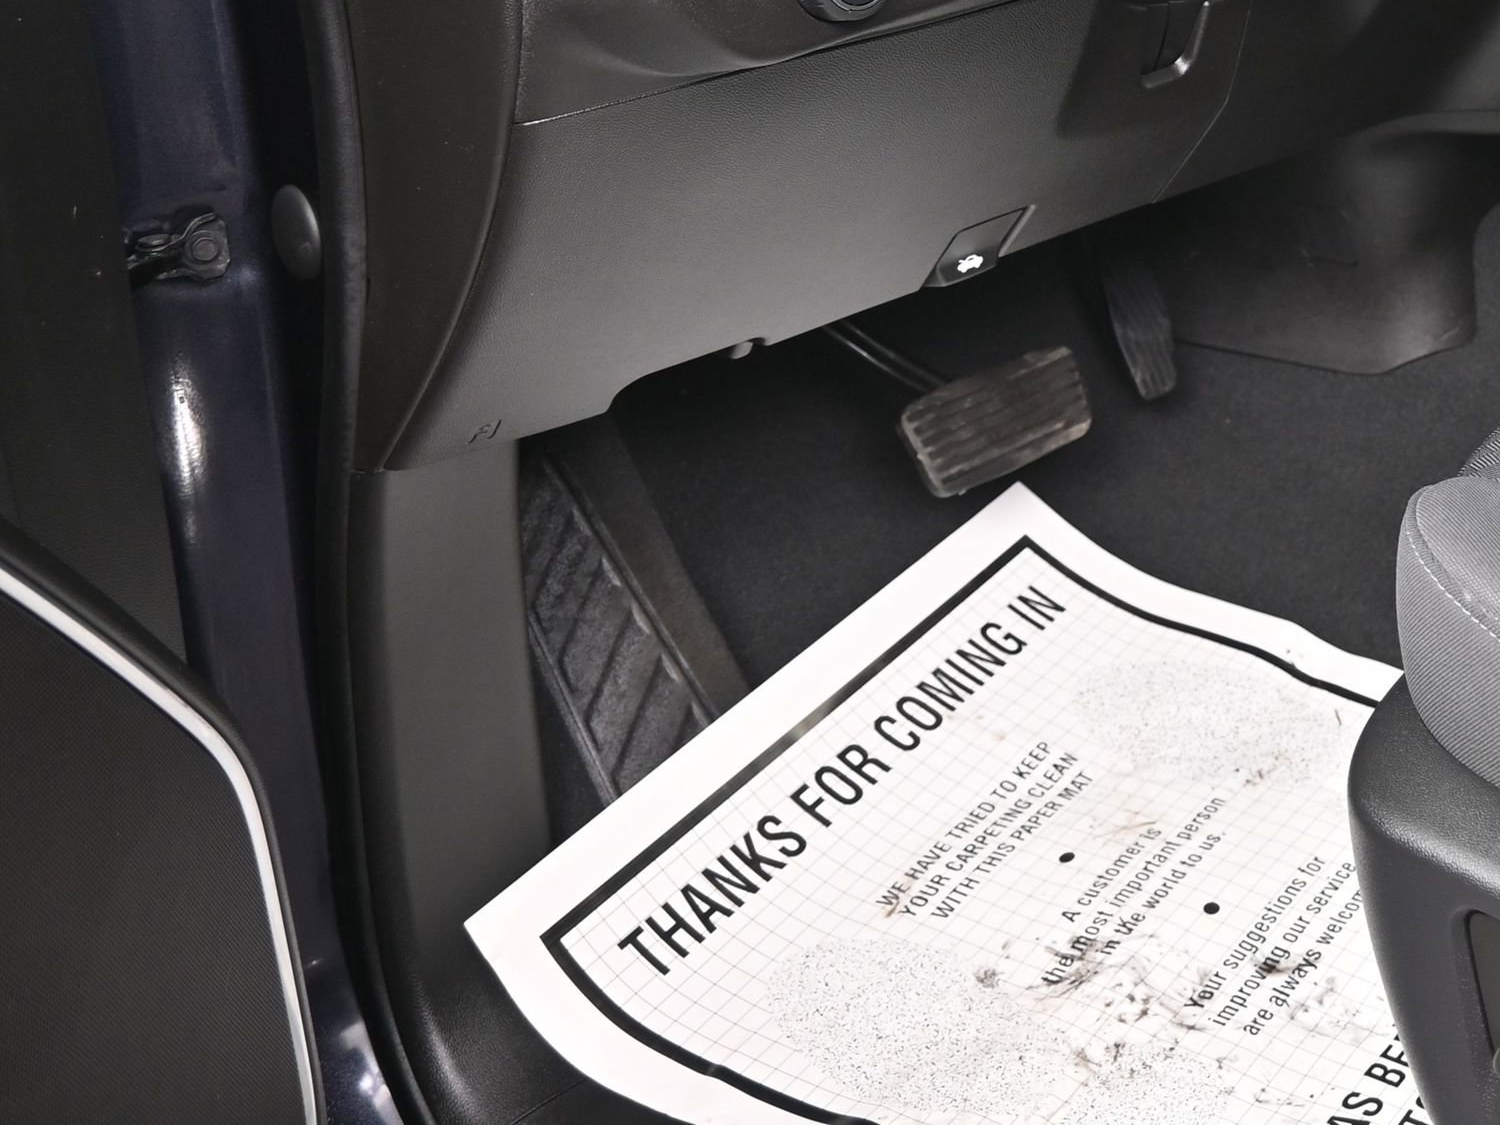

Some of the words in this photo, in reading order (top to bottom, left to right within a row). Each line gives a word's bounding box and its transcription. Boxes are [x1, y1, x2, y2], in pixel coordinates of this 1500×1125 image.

[617, 815, 807, 976] THANKS
[789, 744, 892, 828] FOR
[873, 622, 1028, 752] COMING
[1007, 585, 1067, 631] IN
[875, 881, 912, 908] WE
[904, 840, 953, 881] HAVE
[945, 801, 996, 841] TRIED
[990, 779, 1018, 800] TO
[1012, 741, 1052, 780] KEEP
[899, 874, 951, 918] YOUR
[945, 797, 1032, 873] CARPETING
[1027, 752, 1079, 799] CLEAN
[931, 876, 980, 920] WITH
[973, 842, 1016, 876] THIS
[1010, 800, 1064, 842] PAPER
[1057, 770, 1094, 801] MAT
[1041, 955, 1076, 986] the
[1070, 910, 1114, 952] most
[1105, 840, 1183, 908] important
[1176, 797, 1227, 841] person
[1061, 909, 1082, 923] A
[1077, 840, 1145, 907] customer
[1139, 827, 1163, 841] is
[1142, 868, 1188, 910] world
[1180, 852, 1203, 868] to
[1184, 971, 1227, 1010] Your
[1223, 878, 1307, 970] suggestions
[1298, 856, 1326, 877] for
[1207, 945, 1292, 1027] improving
[1282, 915, 1311, 944] our
[1306, 861, 1357, 915] service
[1243, 1007, 1274, 1036] are
[1269, 948, 1322, 1008] always
[1316, 889, 1363, 946] welcom
